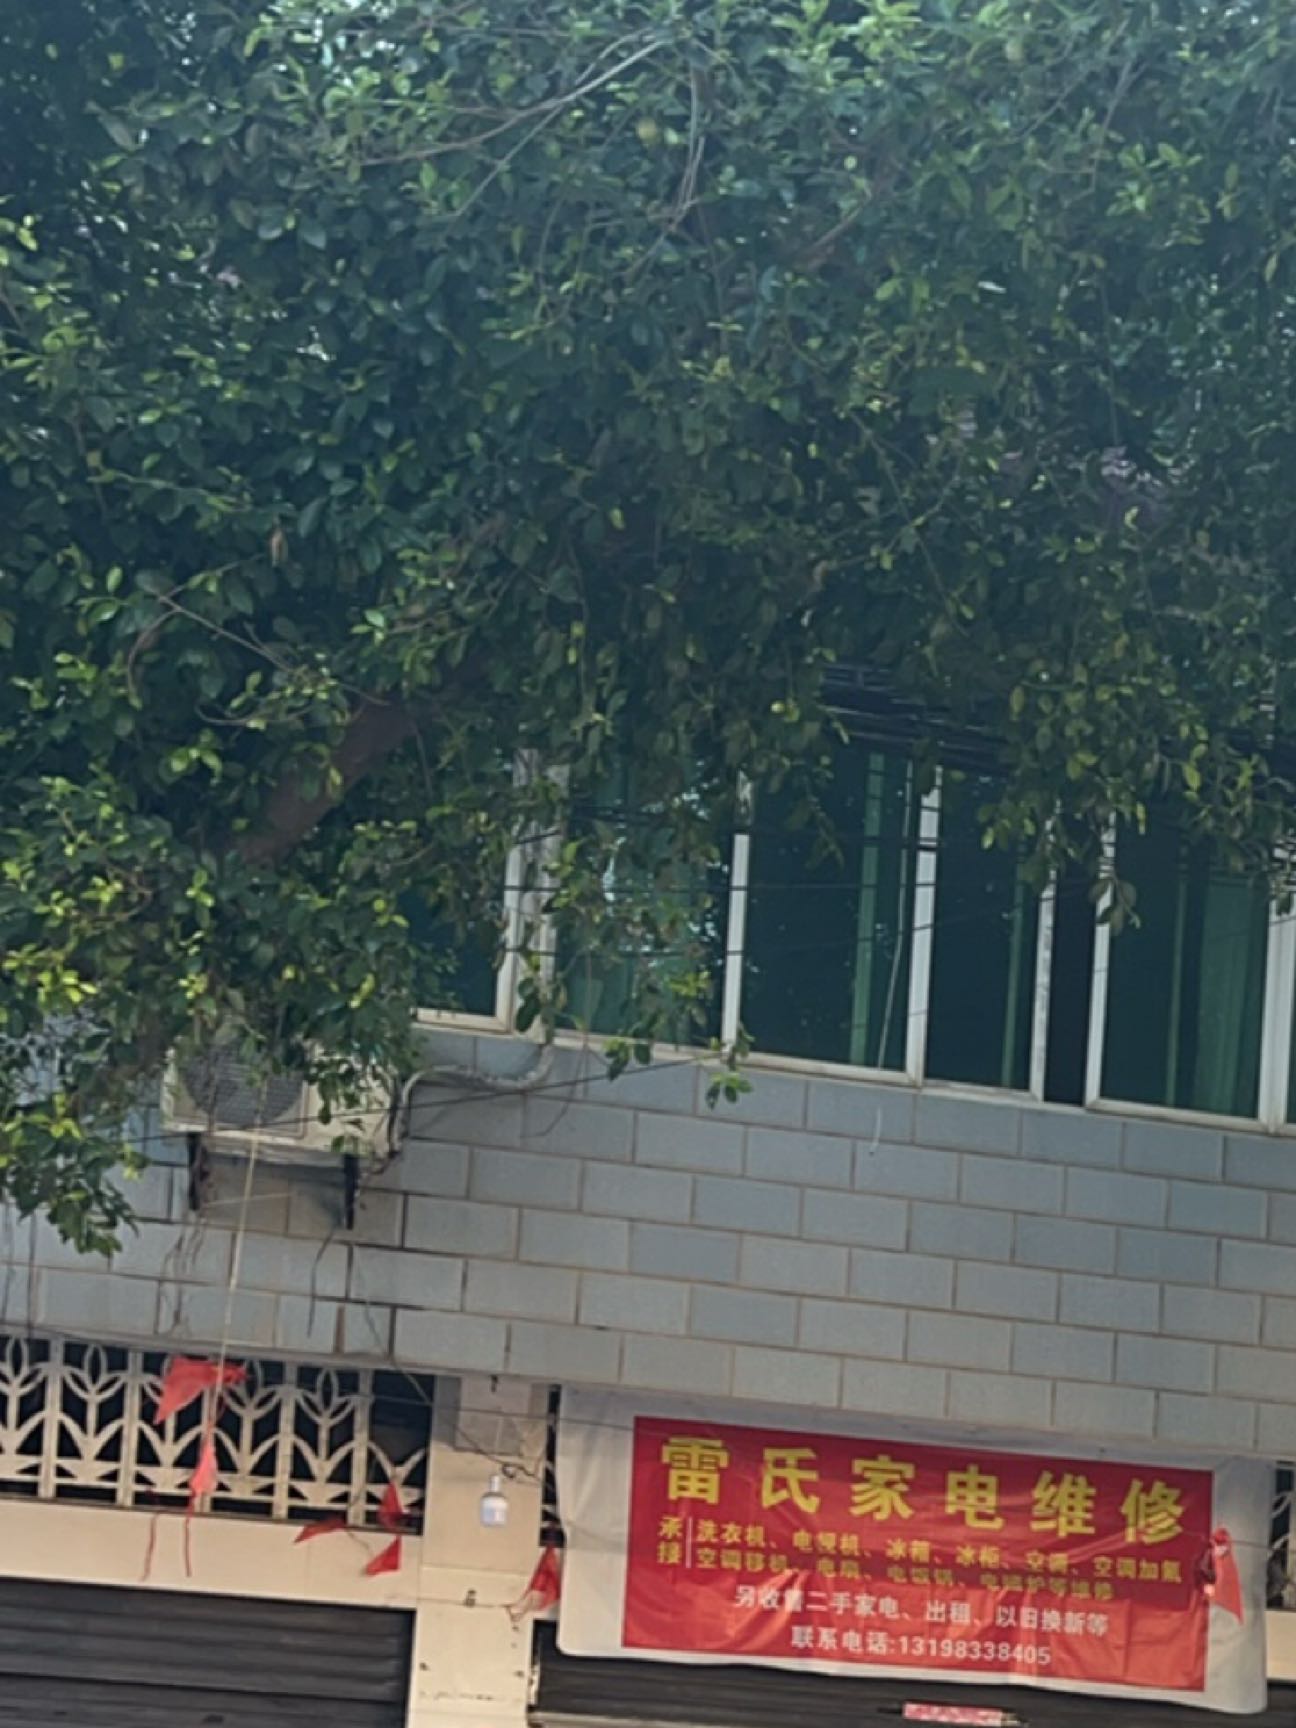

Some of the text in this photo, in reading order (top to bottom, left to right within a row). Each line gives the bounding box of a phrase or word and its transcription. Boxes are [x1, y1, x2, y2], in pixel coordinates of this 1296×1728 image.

[660, 1435, 1187, 1545] 雷氏家电维修
[657, 1516, 683, 1565] 承接
